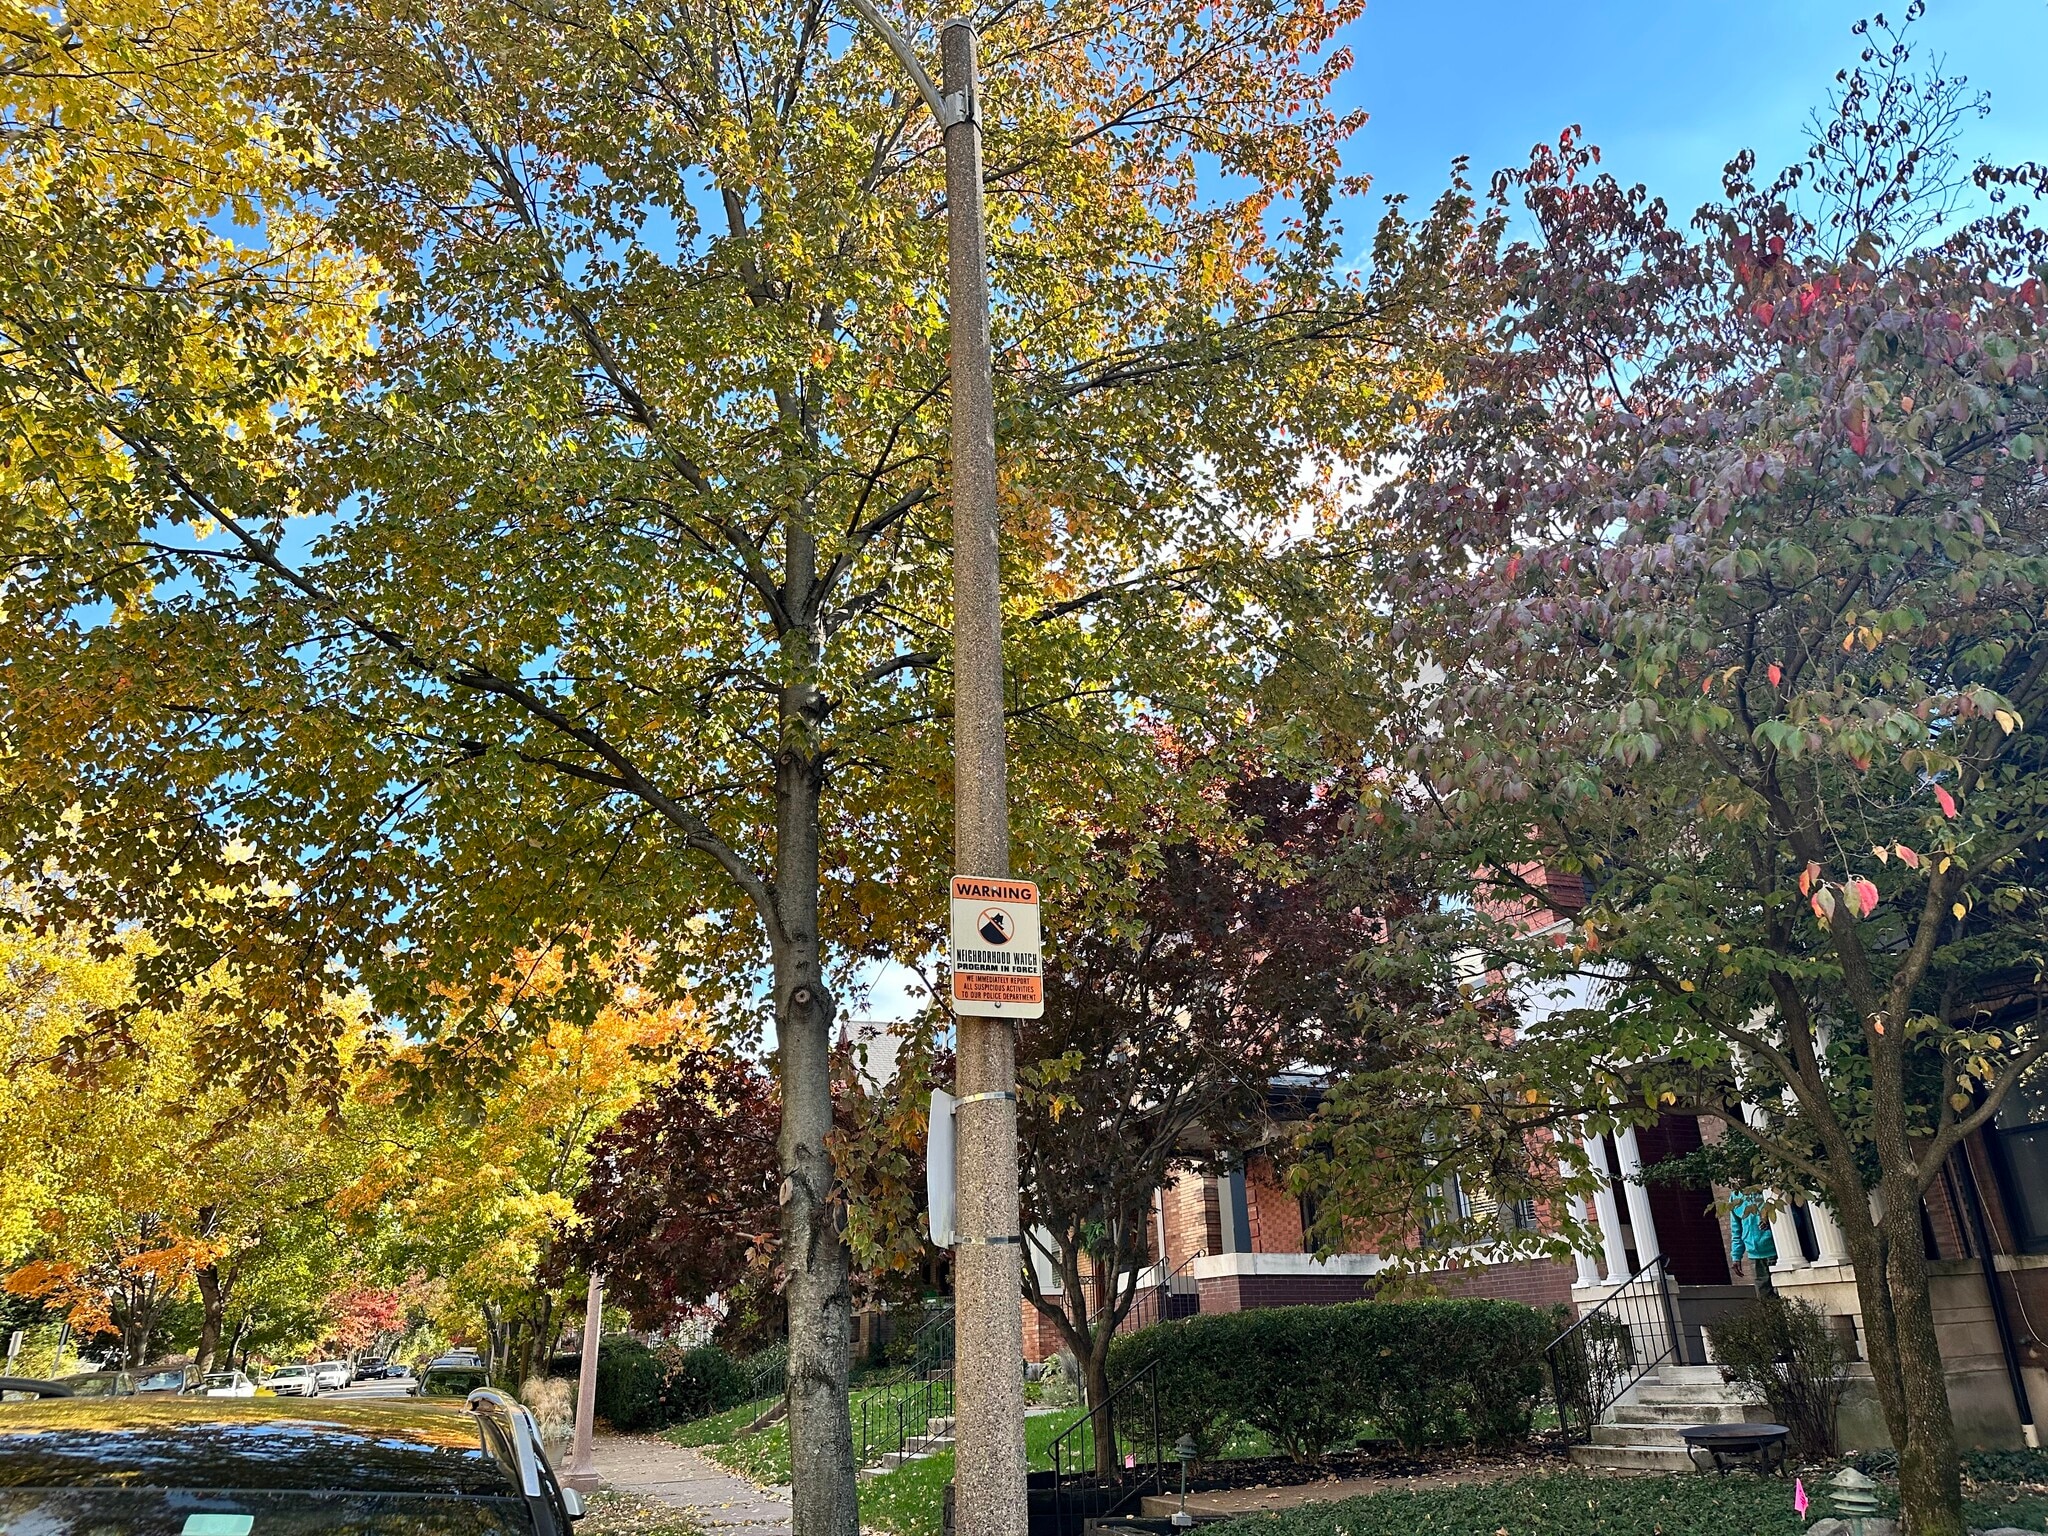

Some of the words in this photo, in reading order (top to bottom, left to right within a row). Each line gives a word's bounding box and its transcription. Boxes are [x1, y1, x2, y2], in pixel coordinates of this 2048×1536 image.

[956, 883, 1032, 900] WARNING
[956, 949, 1011, 964] NEIGHBORHOOD
[1013, 952, 1037, 966] WATCH
[957, 963, 998, 972] PROGRAM
[975, 975, 1009, 984] IMMEDIATELY
[974, 983, 1006, 992] SUSPICIOUS
[1006, 985, 1034, 993] ACTIVITIES
[983, 992, 1002, 1000] POLICE
[1003, 993, 1036, 1001] DEPARTMENT
